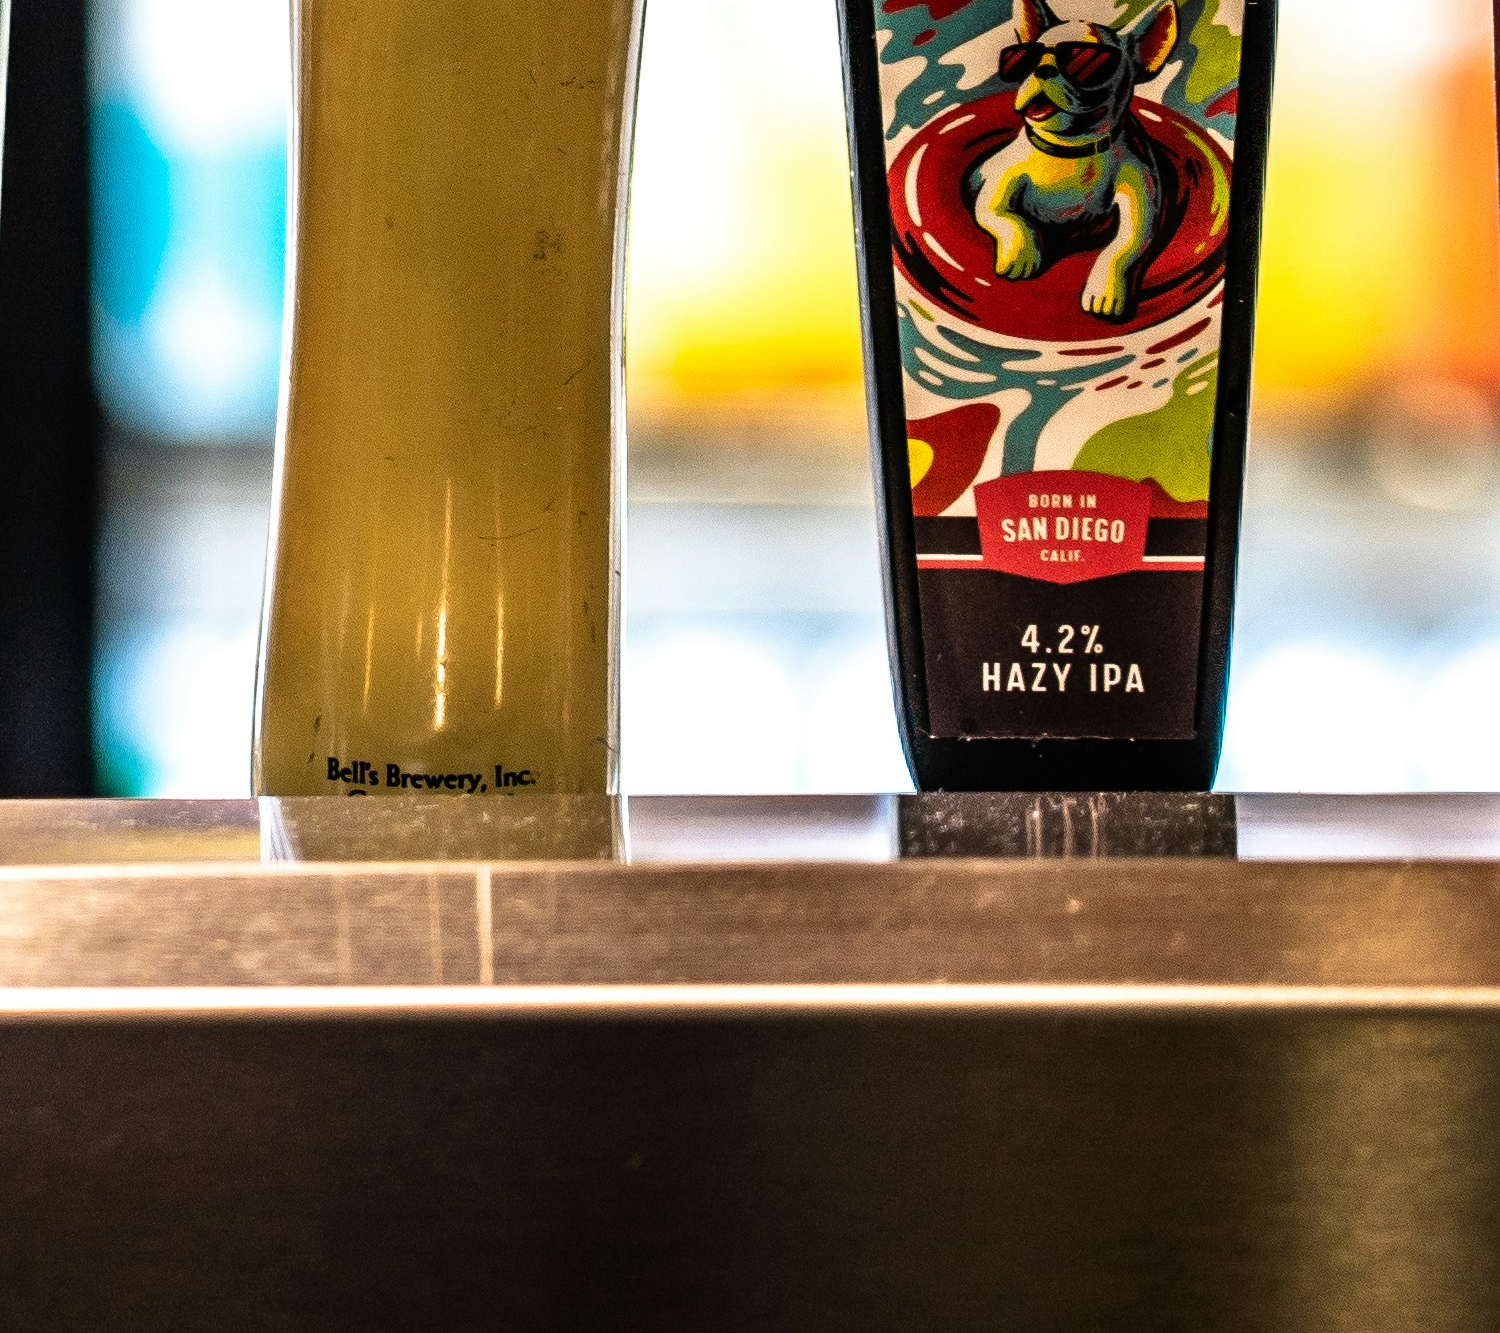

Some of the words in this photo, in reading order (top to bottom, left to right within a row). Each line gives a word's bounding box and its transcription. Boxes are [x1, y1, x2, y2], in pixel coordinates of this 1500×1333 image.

[1028, 493, 1074, 510] BORN
[1080, 493, 1098, 510] IN
[1001, 518, 1047, 543] SAN
[1055, 518, 1126, 544] DIEGO
[1040, 549, 1086, 563] CALIF.
[1021, 623, 1105, 654] 4.2%
[982, 662, 1070, 693] HAZY
[1089, 662, 1145, 693] IPA
[327, 756, 379, 786] Bell's
[386, 764, 487, 793] Brewery,
[495, 764, 536, 788] Inc.
